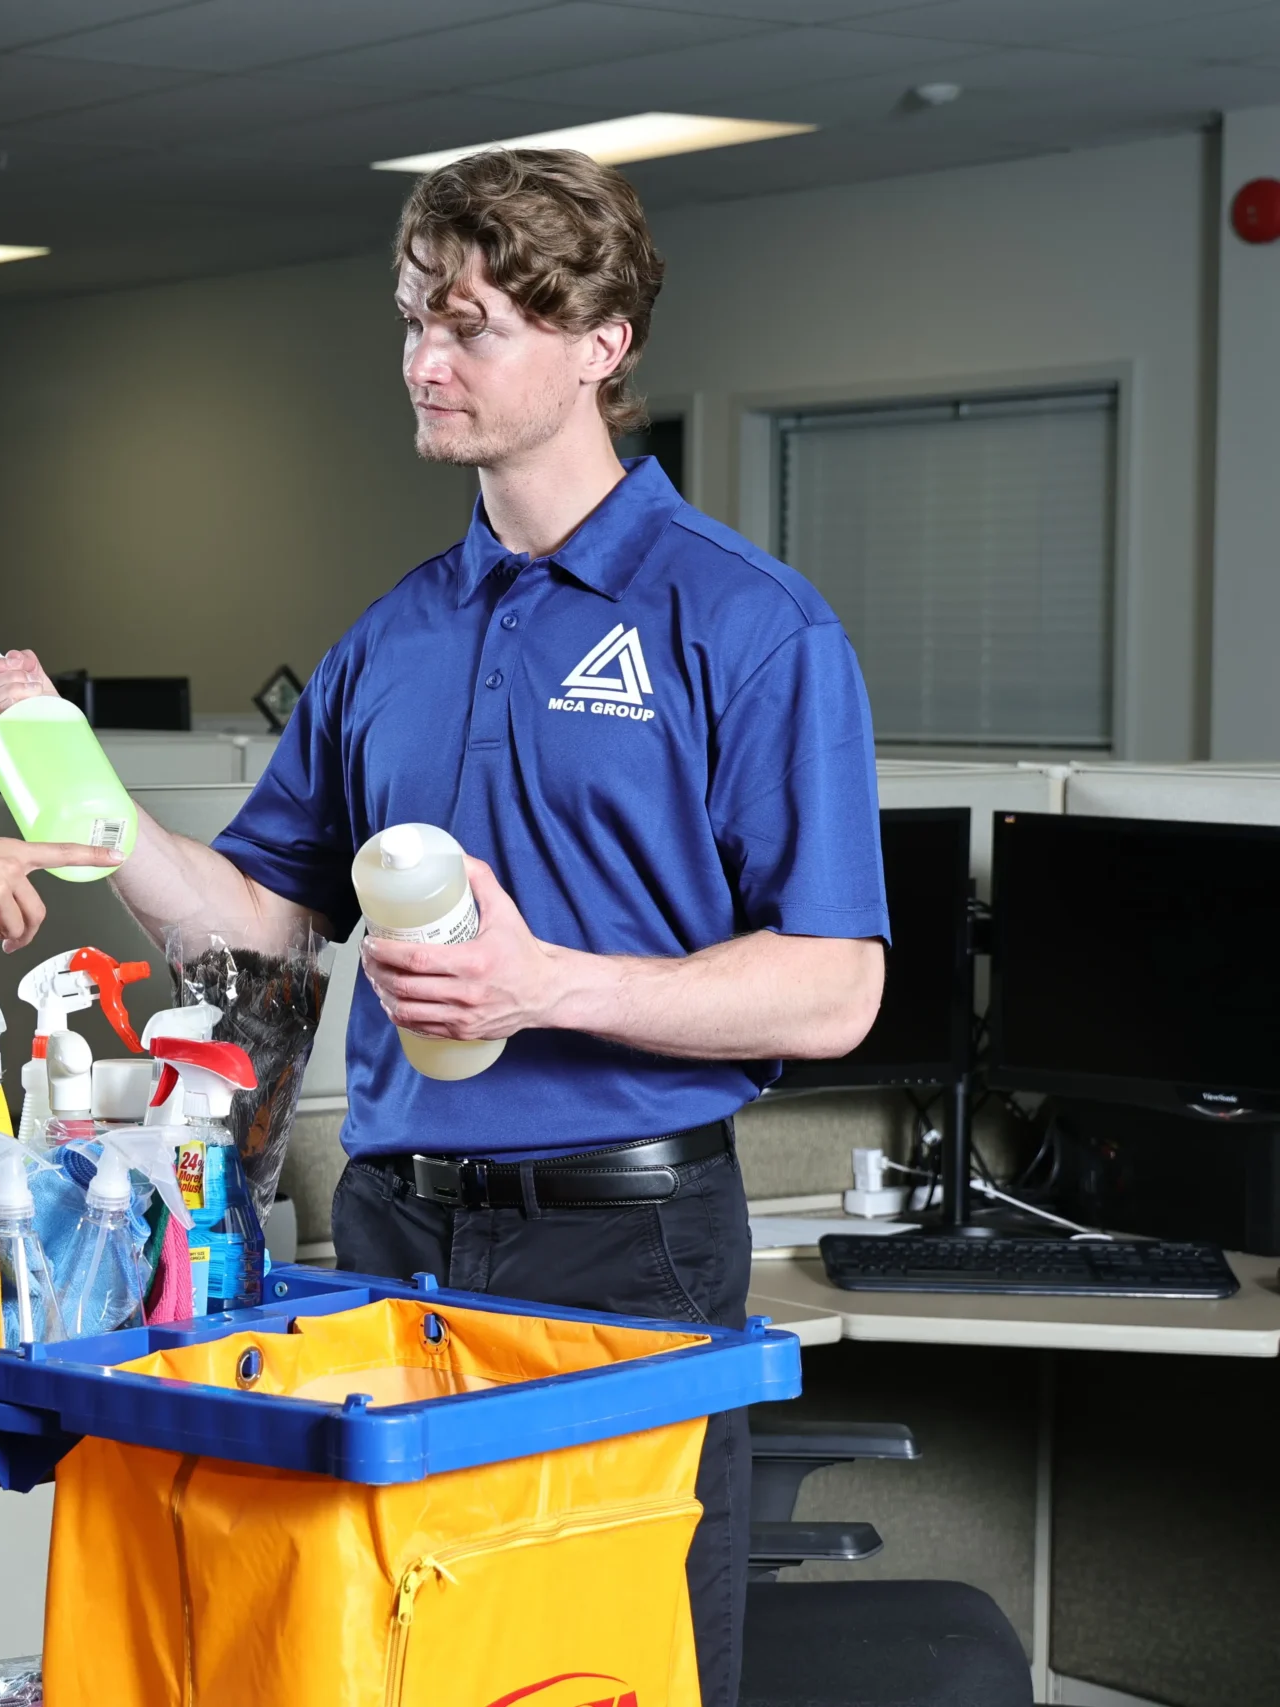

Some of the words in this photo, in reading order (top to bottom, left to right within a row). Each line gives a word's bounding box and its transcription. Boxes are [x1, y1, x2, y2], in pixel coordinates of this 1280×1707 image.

[548, 698, 585, 712] MCA
[590, 702, 655, 722] GROUP
[443, 924, 468, 945] THROOM
[449, 920, 462, 935] EASY
[1202, 1092, 1239, 1104] ViewSonic
[179, 1170, 203, 1184] More!
